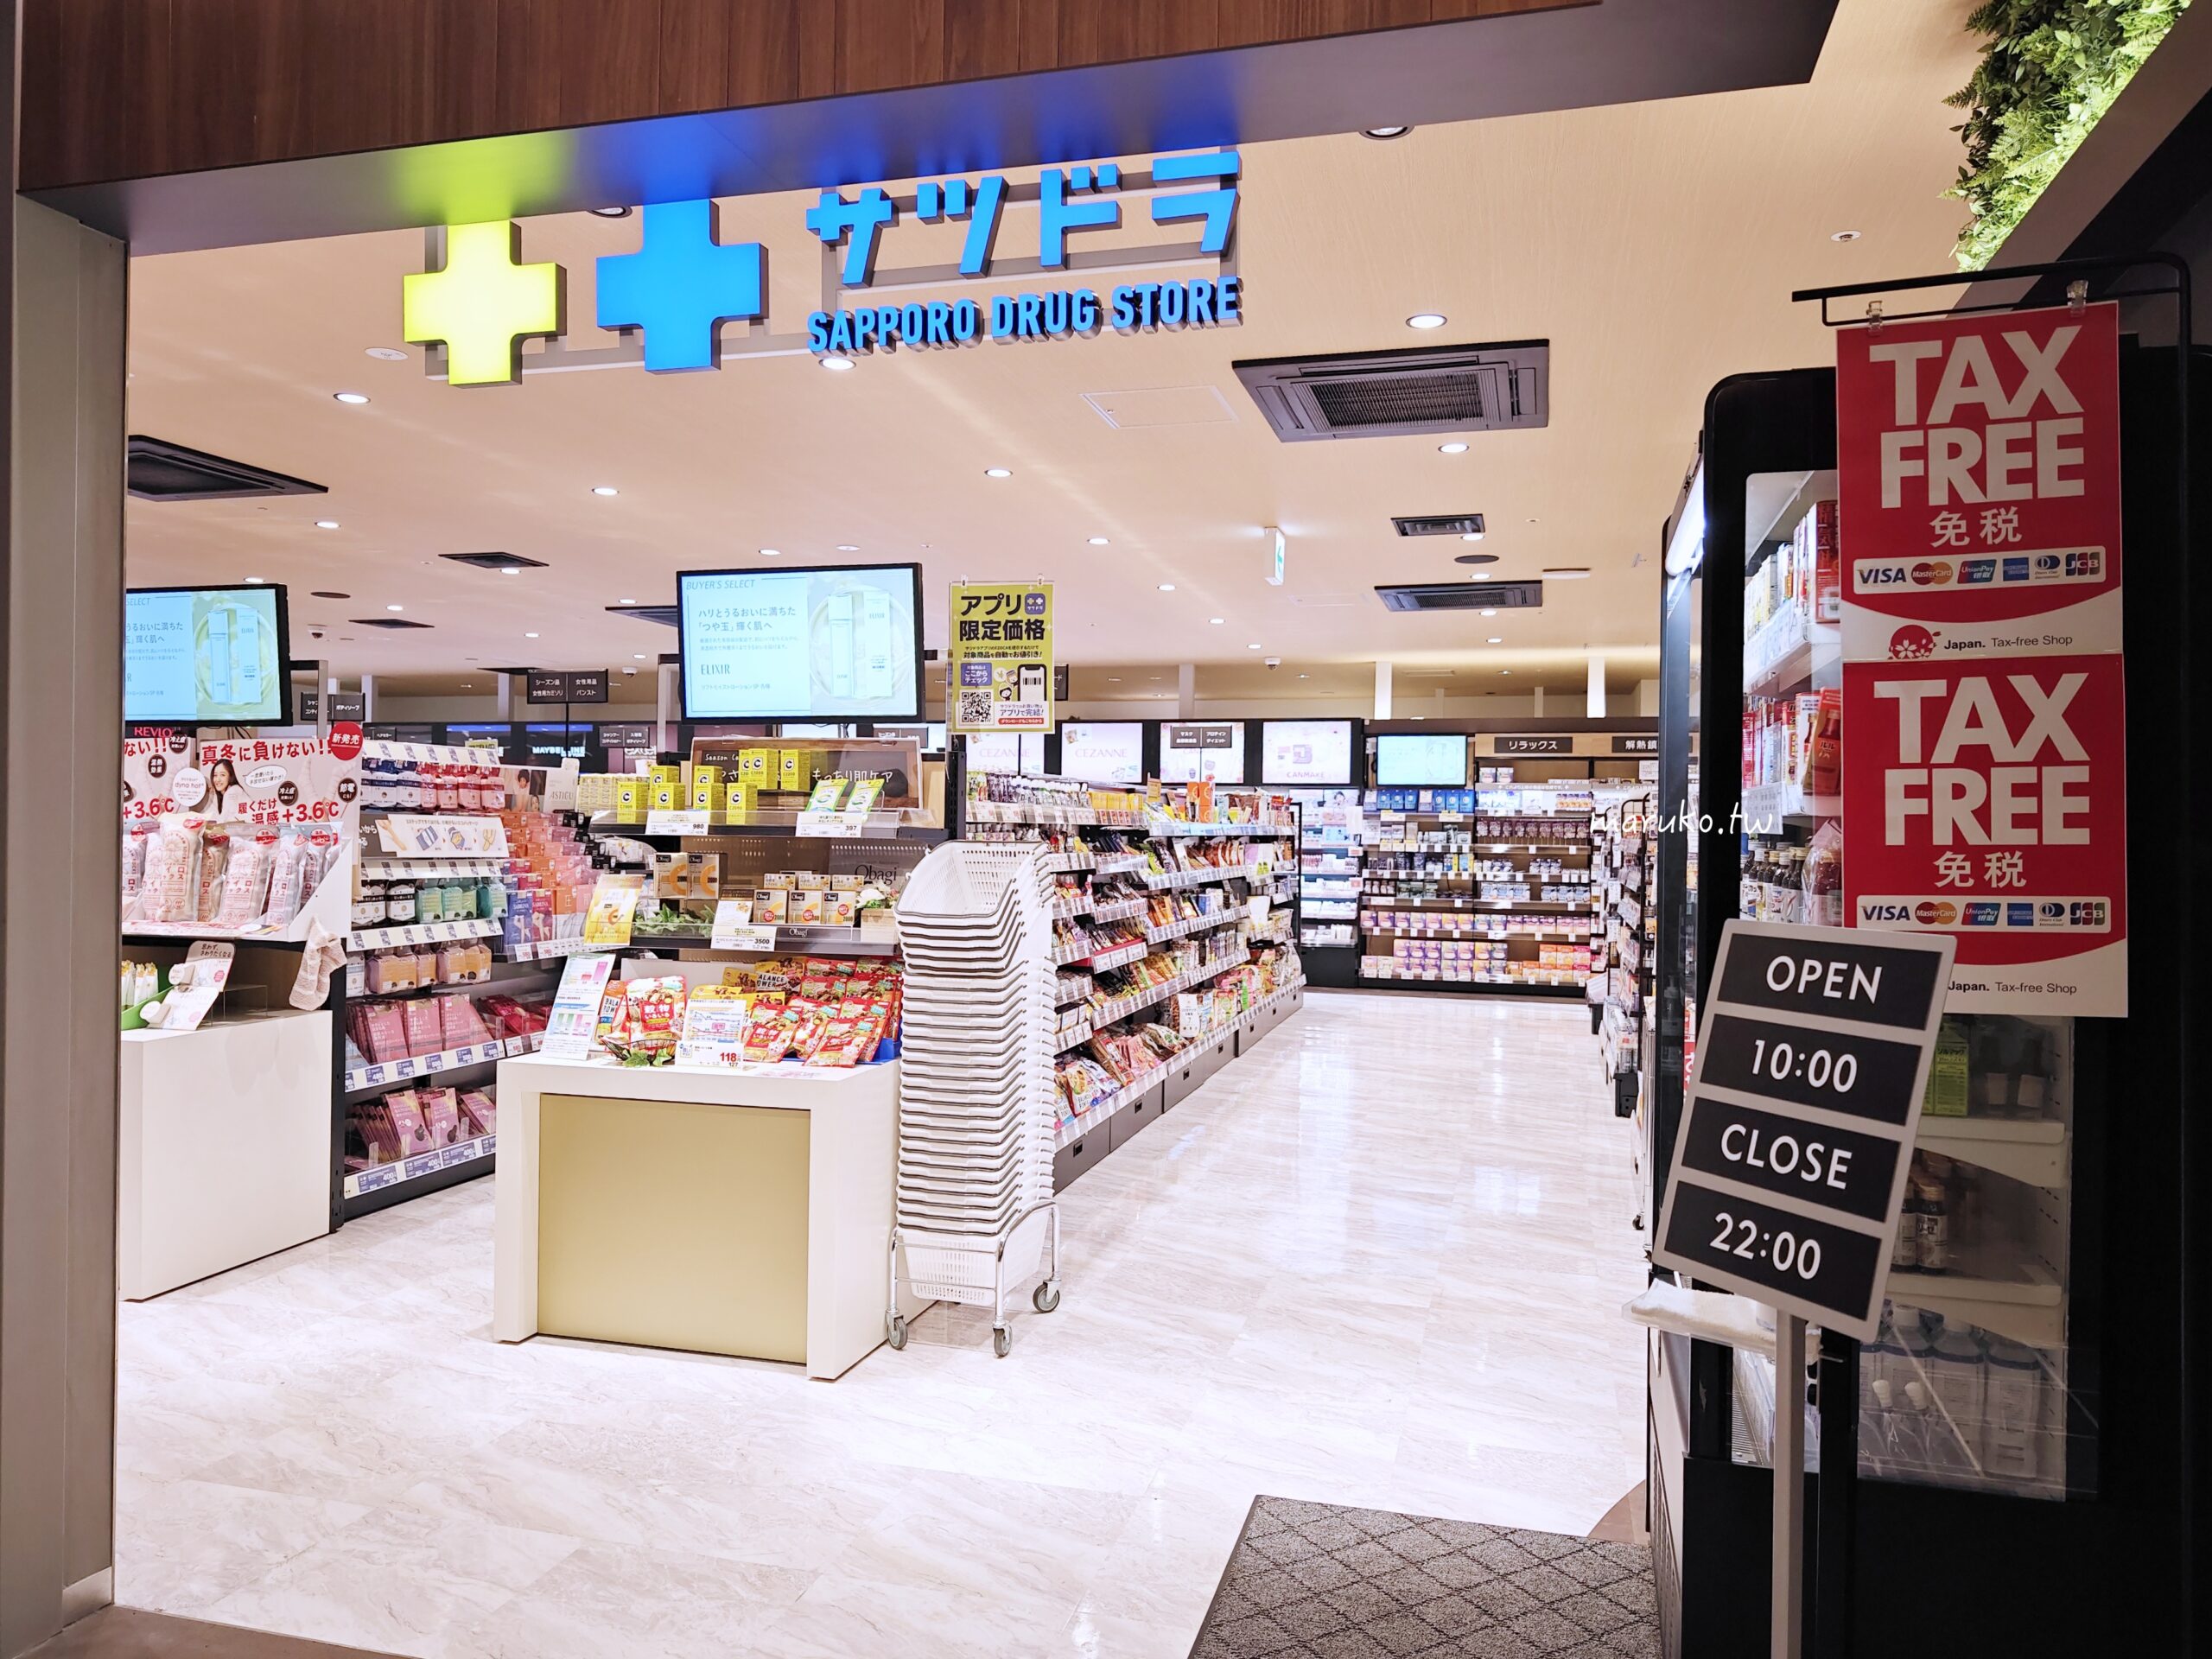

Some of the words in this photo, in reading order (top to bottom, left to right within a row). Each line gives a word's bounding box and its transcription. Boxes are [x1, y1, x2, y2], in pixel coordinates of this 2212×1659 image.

[806, 152, 1239, 286] サツドラ
[806, 298, 976, 354] SAPPORO
[991, 289, 1095, 337] DRUG
[1110, 276, 1238, 326] STORE
[1869, 325, 2084, 426] TAX
[1881, 417, 2084, 508] FREE
[1929, 506, 2022, 548] 免税
[1961, 565, 1994, 575] UnionPay
[2066, 560, 2100, 569] JCB
[1858, 568, 1906, 584] VISA
[1912, 569, 1952, 578] MasterCard
[725, 579, 755, 588] SELECT
[698, 607, 797, 618] ハリとうるおいに満ちた
[961, 593, 1021, 616] アプリ
[960, 619, 1045, 641] 限定価格
[1943, 639, 1986, 651] Japan.
[1991, 636, 2038, 647] Tax-free
[2043, 635, 2073, 647] Shop
[701, 664, 730, 675] ELIXIR
[1873, 672, 2091, 765] TAX
[134, 727, 181, 738] REVLO
[332, 733, 360, 745] 新発売
[1075, 748, 1128, 758] CEZANNE
[1509, 740, 1558, 750] リラックス
[812, 767, 893, 783] もっちり肌ケア
[238, 798, 276, 814] 履くだけ
[1885, 766, 2091, 846] FREE
[855, 864, 897, 886] Obagi
[1934, 850, 2027, 889] 免税
[1861, 906, 1910, 921] VISA
[1916, 909, 1956, 918] MasterCard
[1965, 907, 1999, 917] UnionPay
[2070, 910, 2104, 918] JCB
[789, 927, 808, 938] Obagi
[757, 974, 785, 982] ALANCE
[1766, 955, 1882, 1004] OPEN
[1948, 981, 1990, 993] Japan.
[1995, 982, 2043, 993] Tax-free
[2046, 982, 2077, 995] Shop
[720, 1052, 737, 1062] 118
[1751, 1039, 1858, 1093] 10:00
[1720, 1124, 1853, 1189] CLOSE
[1709, 1212, 1821, 1280] 22:00
